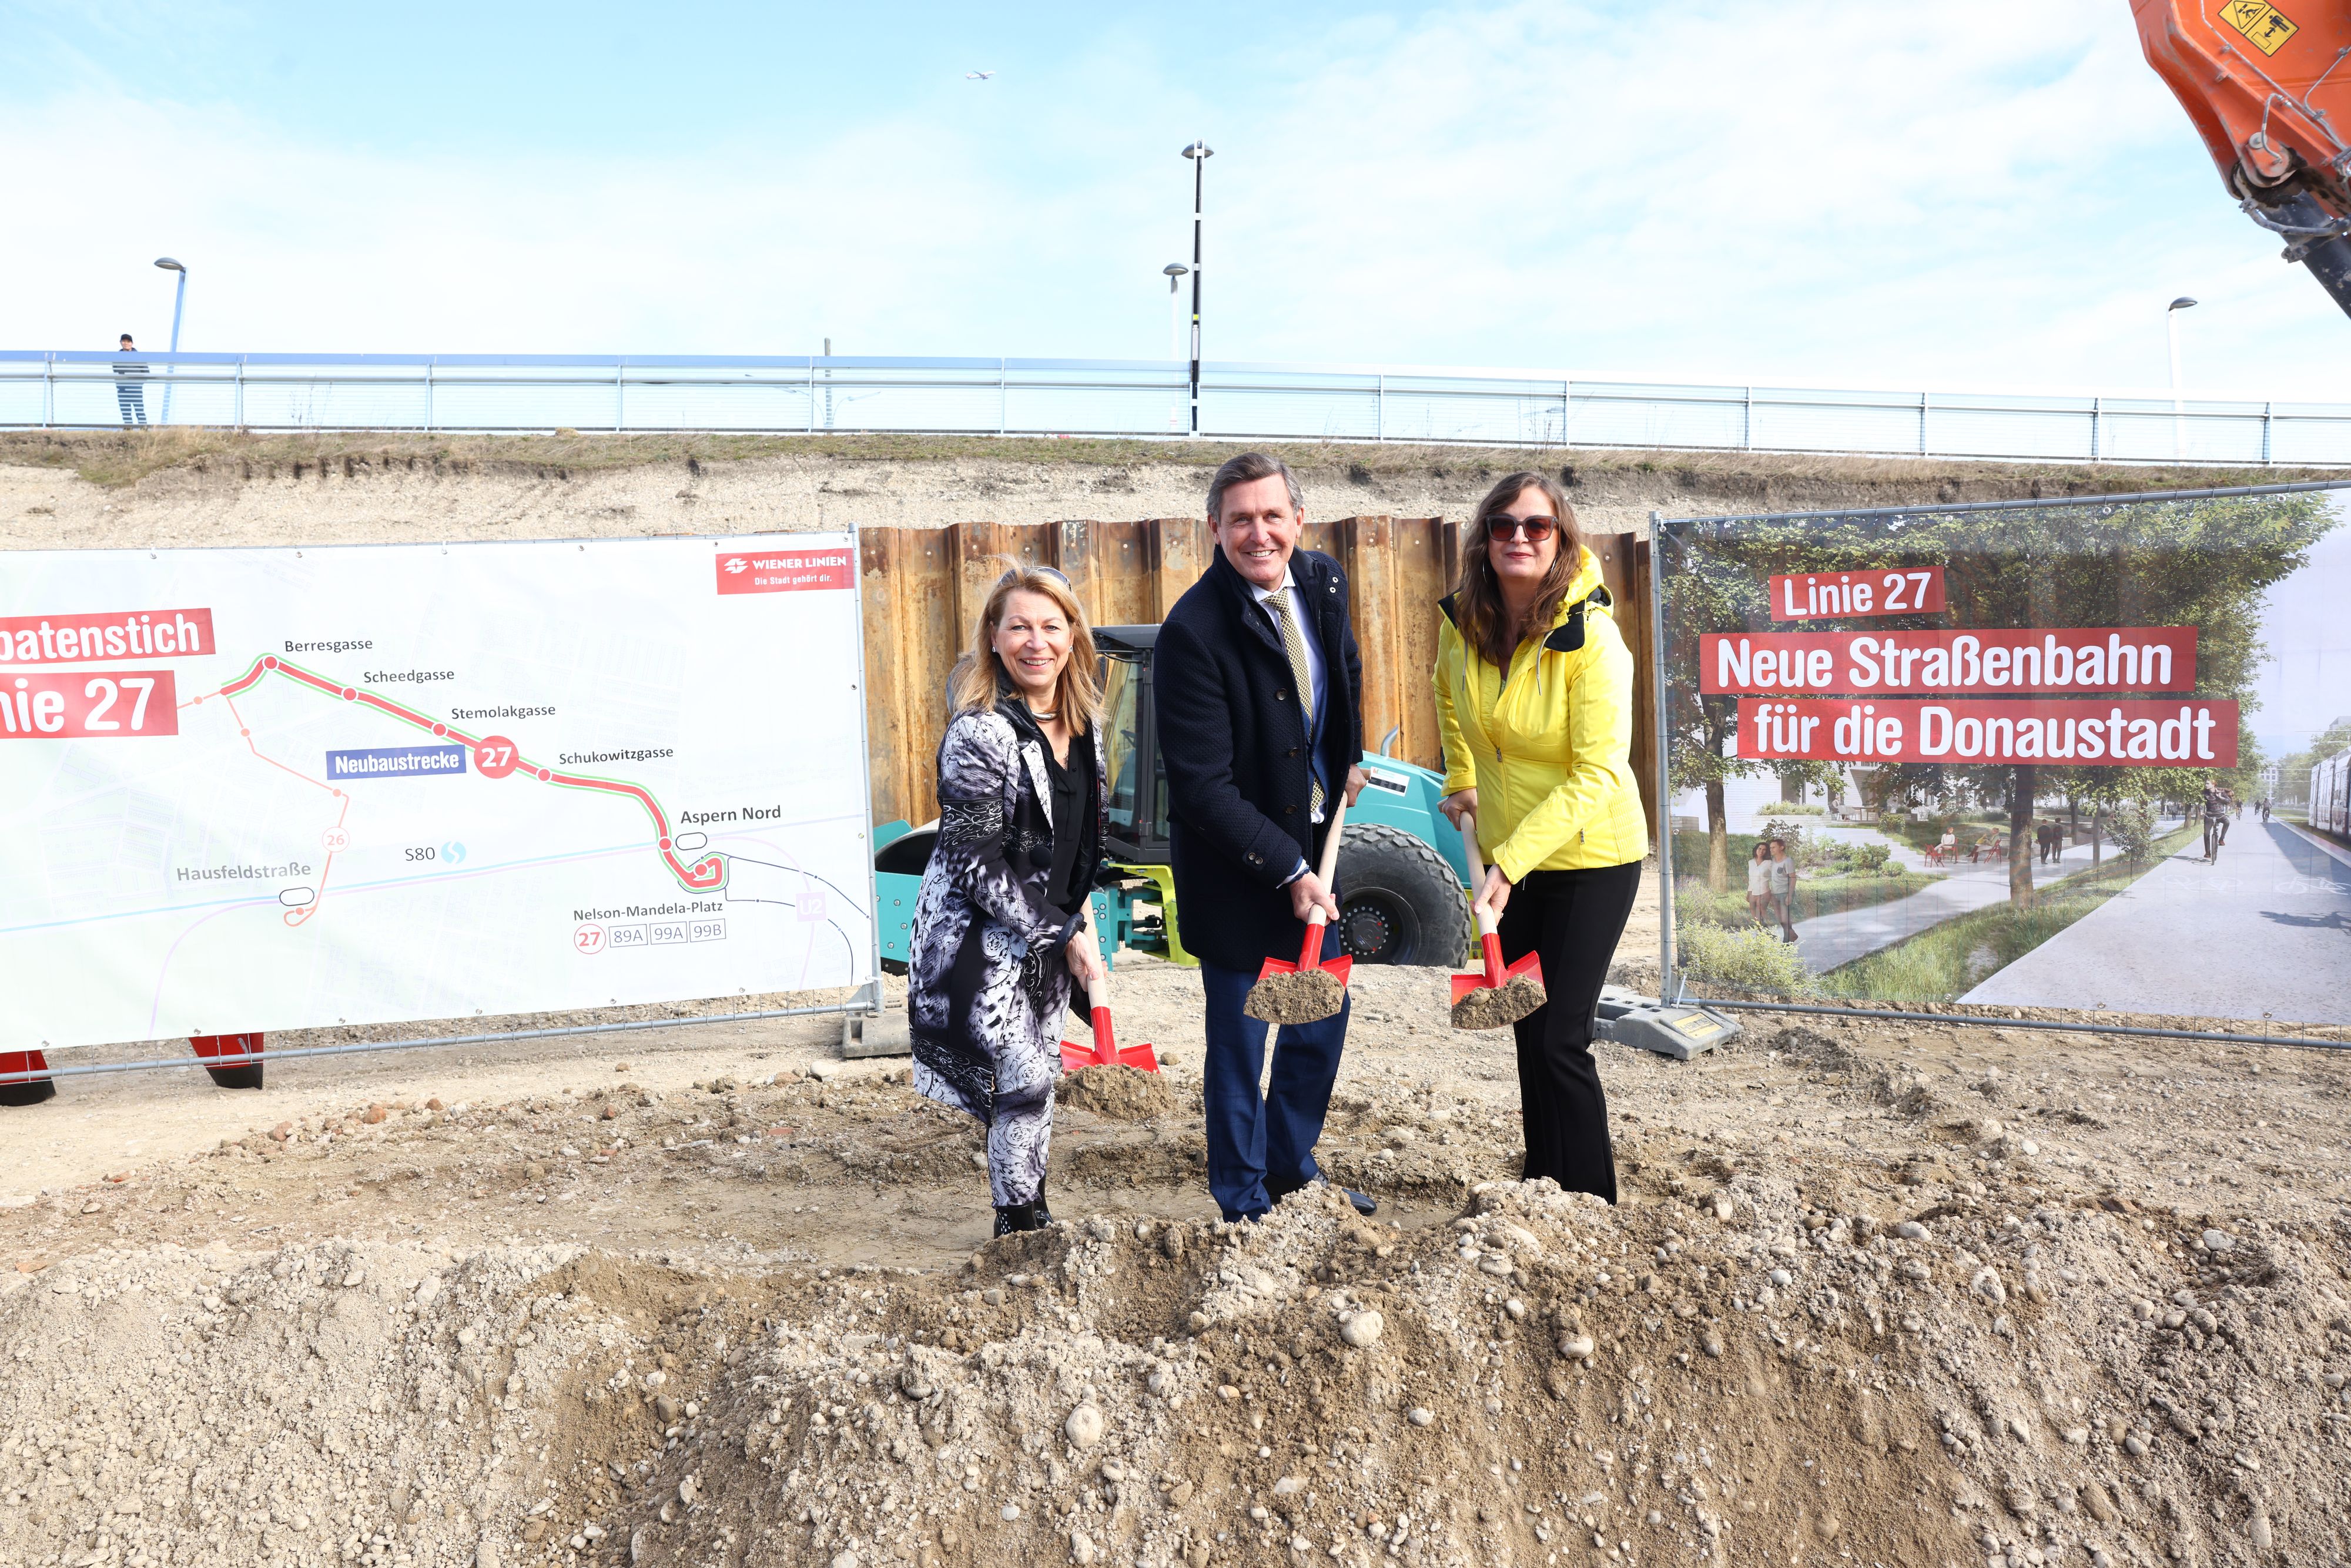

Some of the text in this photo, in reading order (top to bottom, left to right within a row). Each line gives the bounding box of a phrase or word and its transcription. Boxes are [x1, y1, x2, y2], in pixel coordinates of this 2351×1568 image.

[752, 556, 847, 570] WIENER LINIEN
[754, 574, 832, 585] Die Stadt gehört dir.
[1784, 572, 1932, 616] Linie 27
[285, 640, 373, 653] Berresgasse
[1717, 633, 2172, 688] Neue Straßenbahn
[364, 669, 455, 684] Scheedgasse
[84, 678, 156, 731] 27
[451, 705, 555, 719] Stemolakgasse
[1753, 703, 2216, 760] für die Donaustadt
[334, 751, 460, 774] Neubaustrecke
[481, 746, 513, 768] 27
[559, 748, 674, 765] Schukowitzgasse
[680, 805, 782, 826] Aspern Nord
[327, 834, 345, 846] 26
[405, 847, 436, 862] S80
[176, 862, 312, 881] Hausfeldstraße
[573, 901, 724, 921] Nelson-Mandela-Platz
[799, 898, 824, 915] U2
[578, 931, 601, 947] 27
[614, 929, 643, 943] 89A
[654, 926, 684, 940] 99A
[694, 924, 722, 938] 99B
